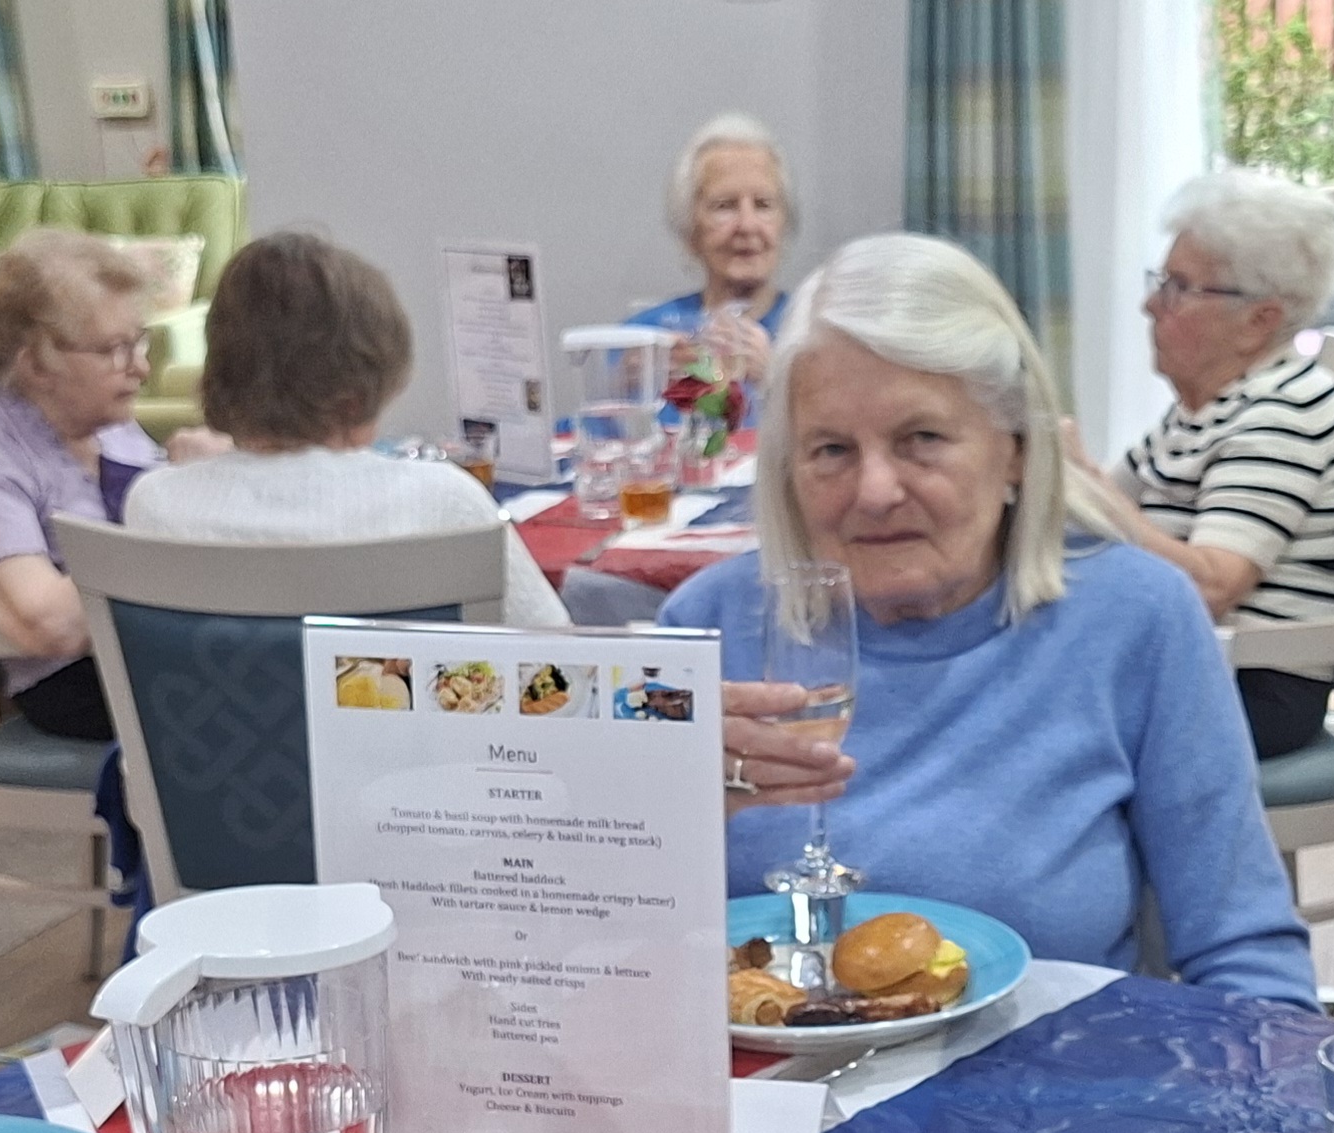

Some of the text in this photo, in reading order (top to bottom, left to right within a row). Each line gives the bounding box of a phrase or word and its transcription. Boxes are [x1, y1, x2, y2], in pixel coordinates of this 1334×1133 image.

[488, 743, 538, 764] Menu
[488, 787, 543, 801] STARTER
[391, 807, 646, 831] Tomato & basil soup with homemade milk bread
[377, 821, 426, 836] (chopped
[512, 829, 545, 843] celery
[547, 831, 556, 841] &
[558, 831, 583, 843] basil
[585, 833, 596, 843] in
[607, 836, 627, 848] veg
[628, 835, 663, 850] stock)
[503, 857, 534, 869] MAIN
[473, 870, 567, 886] Battered haddock
[401, 880, 447, 894] Haddock
[449, 883, 479, 895] fillets
[481, 886, 518, 898] cooked
[521, 889, 531, 898] in
[542, 889, 601, 902] homemade
[602, 894, 636, 908] crispy
[638, 894, 677, 909] batter)
[432, 897, 611, 920] With tartare sauce & lemon wedge
[515, 930, 529, 941] Or
[423, 954, 471, 967] sandwich
[473, 957, 497, 968] with
[499, 959, 523, 972] pink
[525, 960, 564, 973] pickled
[565, 964, 602, 975] onions
[603, 965, 612, 976] &
[614, 964, 653, 979] lettuce
[461, 970, 586, 990] With ready salted crisps
[510, 1002, 539, 1014] Sides
[489, 1015, 562, 1030] Hand cut fries
[492, 1029, 538, 1043] Buttered
[501, 1072, 552, 1086] DESSERT
[498, 1086, 514, 1097] Ice
[516, 1087, 549, 1100] Cream
[551, 1090, 576, 1101] with
[577, 1092, 624, 1107] toppings
[485, 1100, 577, 1117] Cheese & Biscuits
